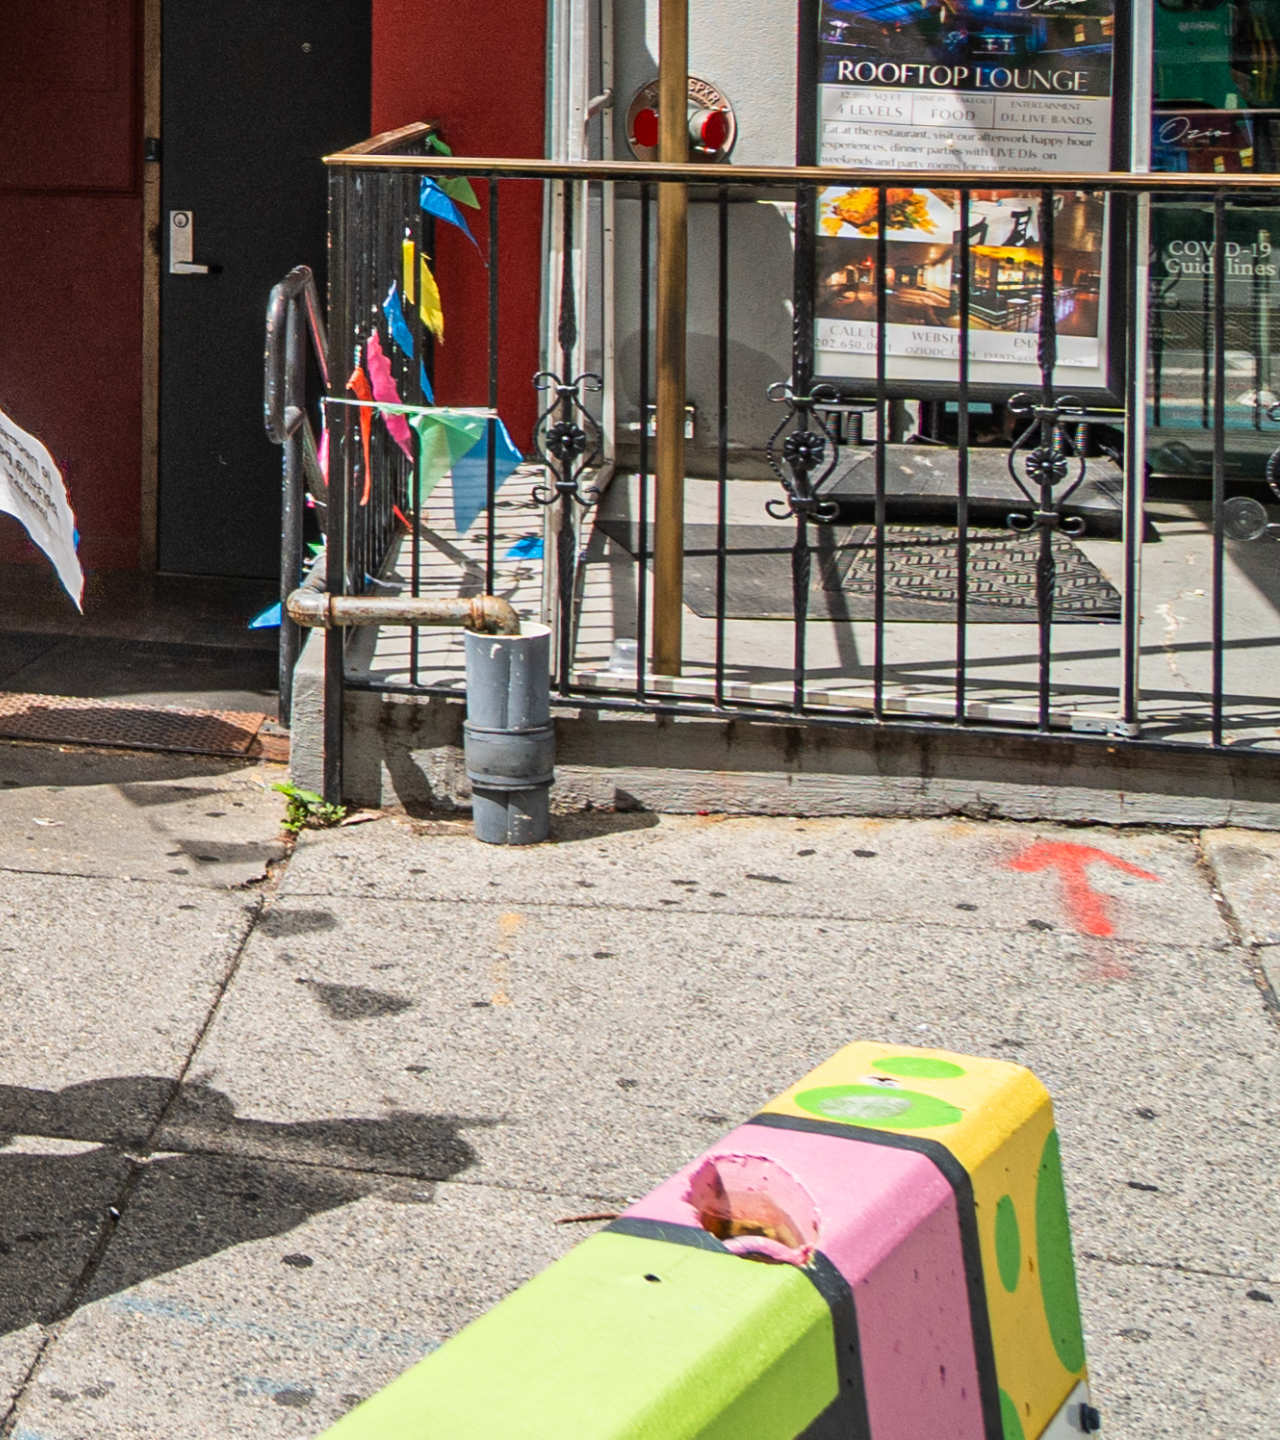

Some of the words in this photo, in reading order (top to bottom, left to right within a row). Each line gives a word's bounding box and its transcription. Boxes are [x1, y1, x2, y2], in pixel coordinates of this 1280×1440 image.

[838, 60, 969, 86] ROOFTOP
[975, 66, 1089, 92] LOUNGE
[849, 104, 903, 117] LEVELS
[931, 108, 976, 121] FOOD
[1158, 116, 1232, 143] Ozio
[1067, 136, 1093, 147] hour
[1042, 151, 1057, 160] on
[1168, 240, 1272, 258] COVD-19
[1164, 257, 1277, 276] Guidlines
